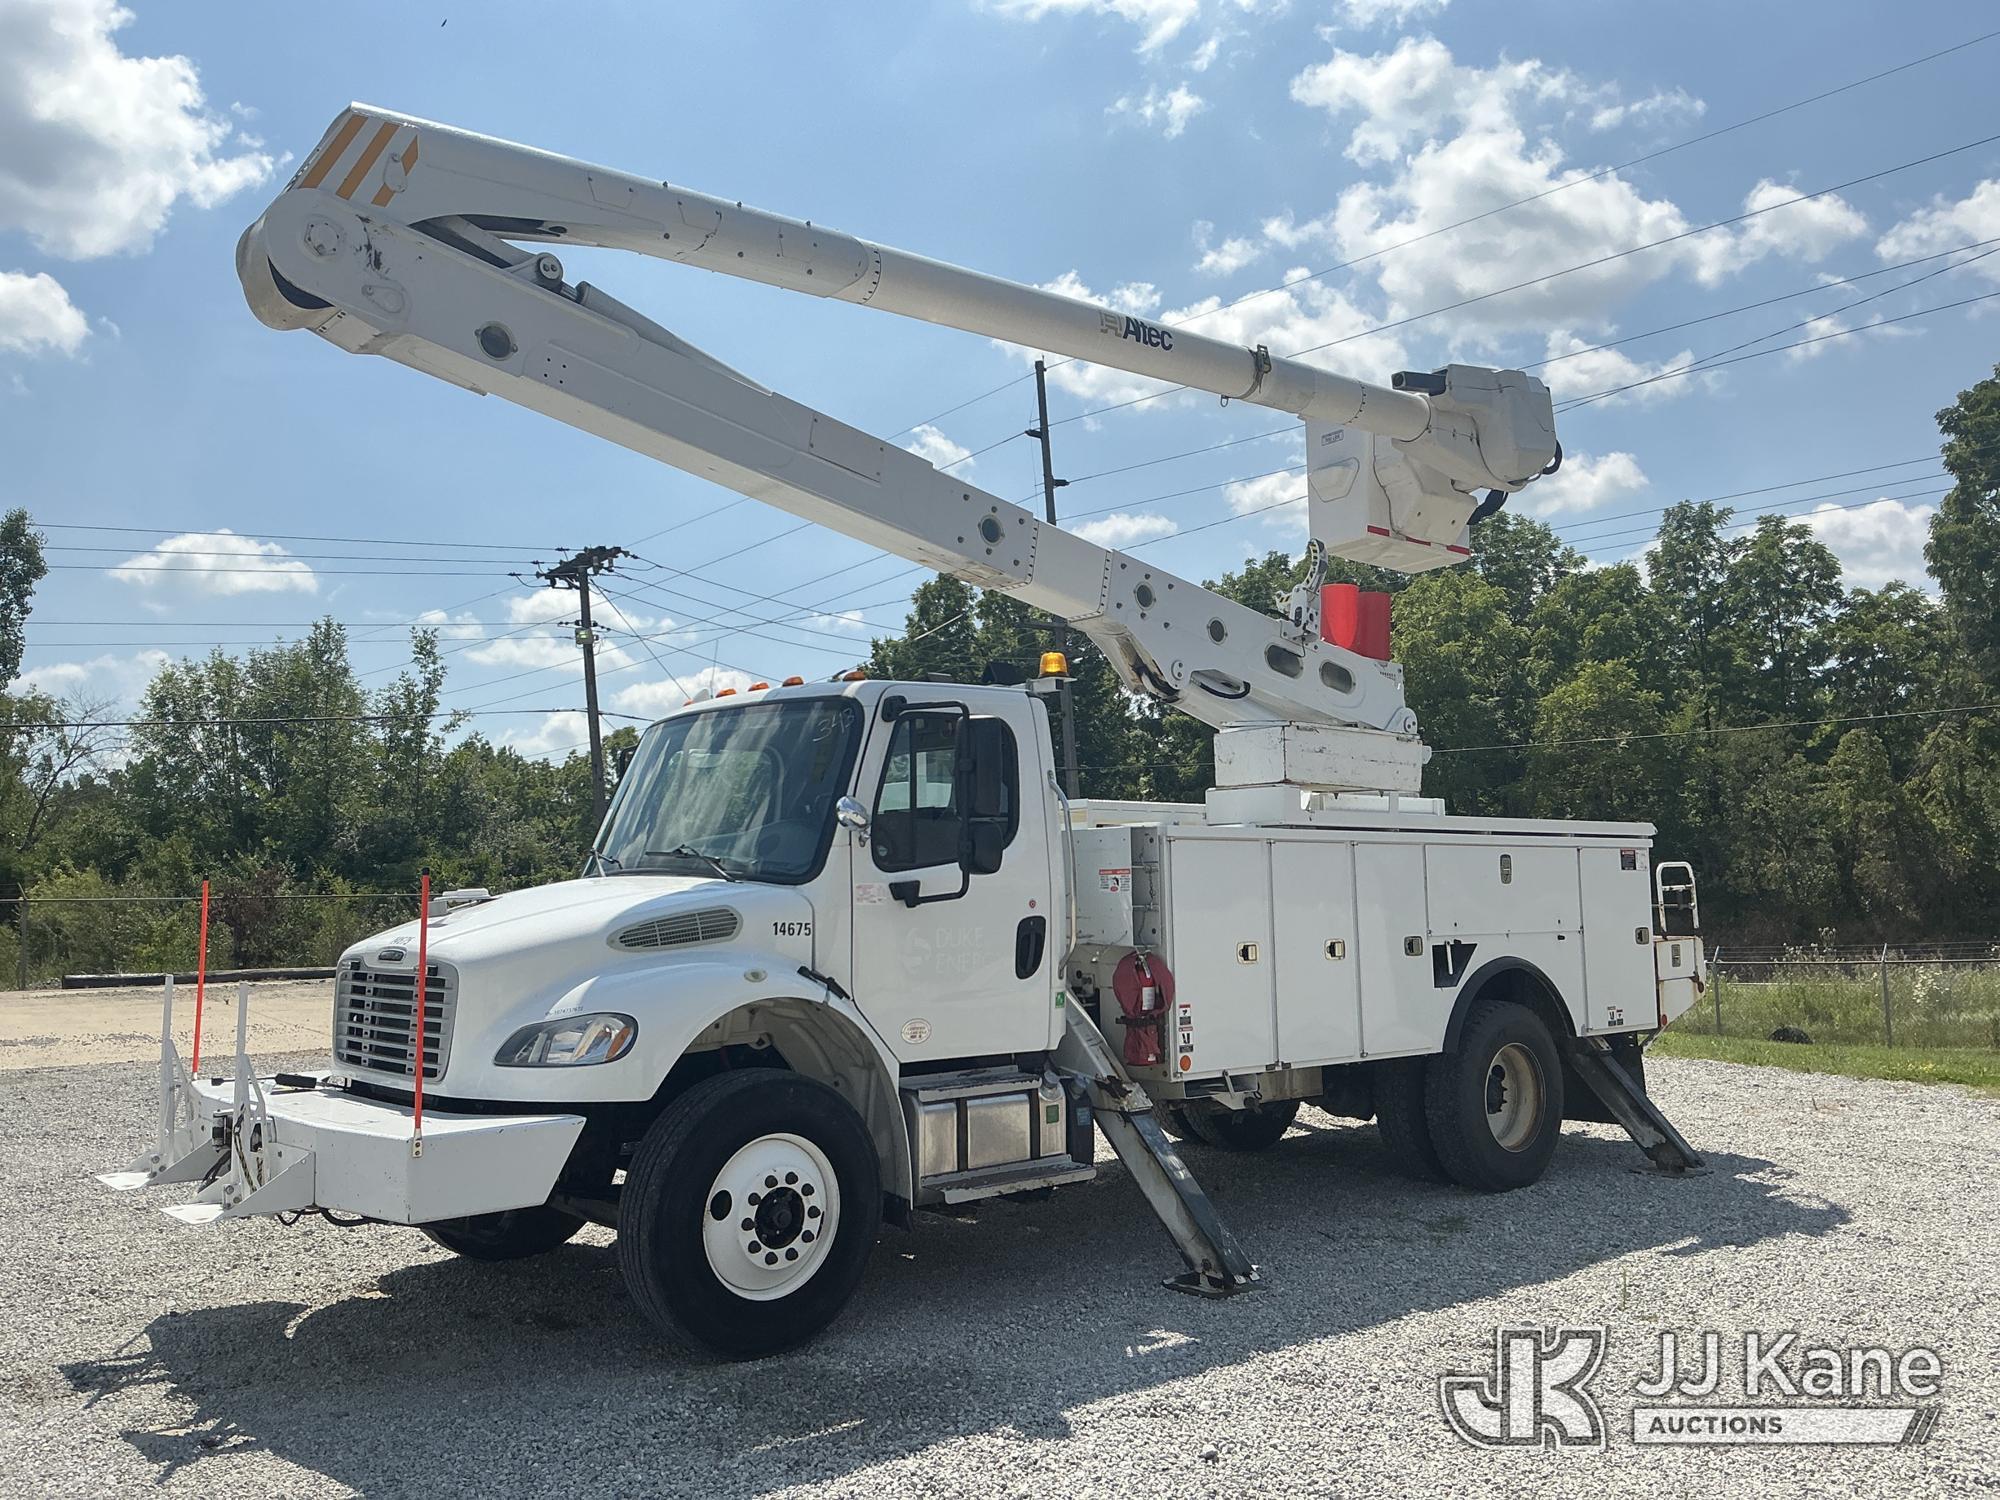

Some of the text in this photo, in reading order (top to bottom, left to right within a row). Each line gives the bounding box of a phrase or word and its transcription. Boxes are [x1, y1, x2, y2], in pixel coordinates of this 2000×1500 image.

[1123, 316, 1174, 351] Altec
[772, 921, 812, 937] 14675
[935, 926, 985, 949] DUKE
